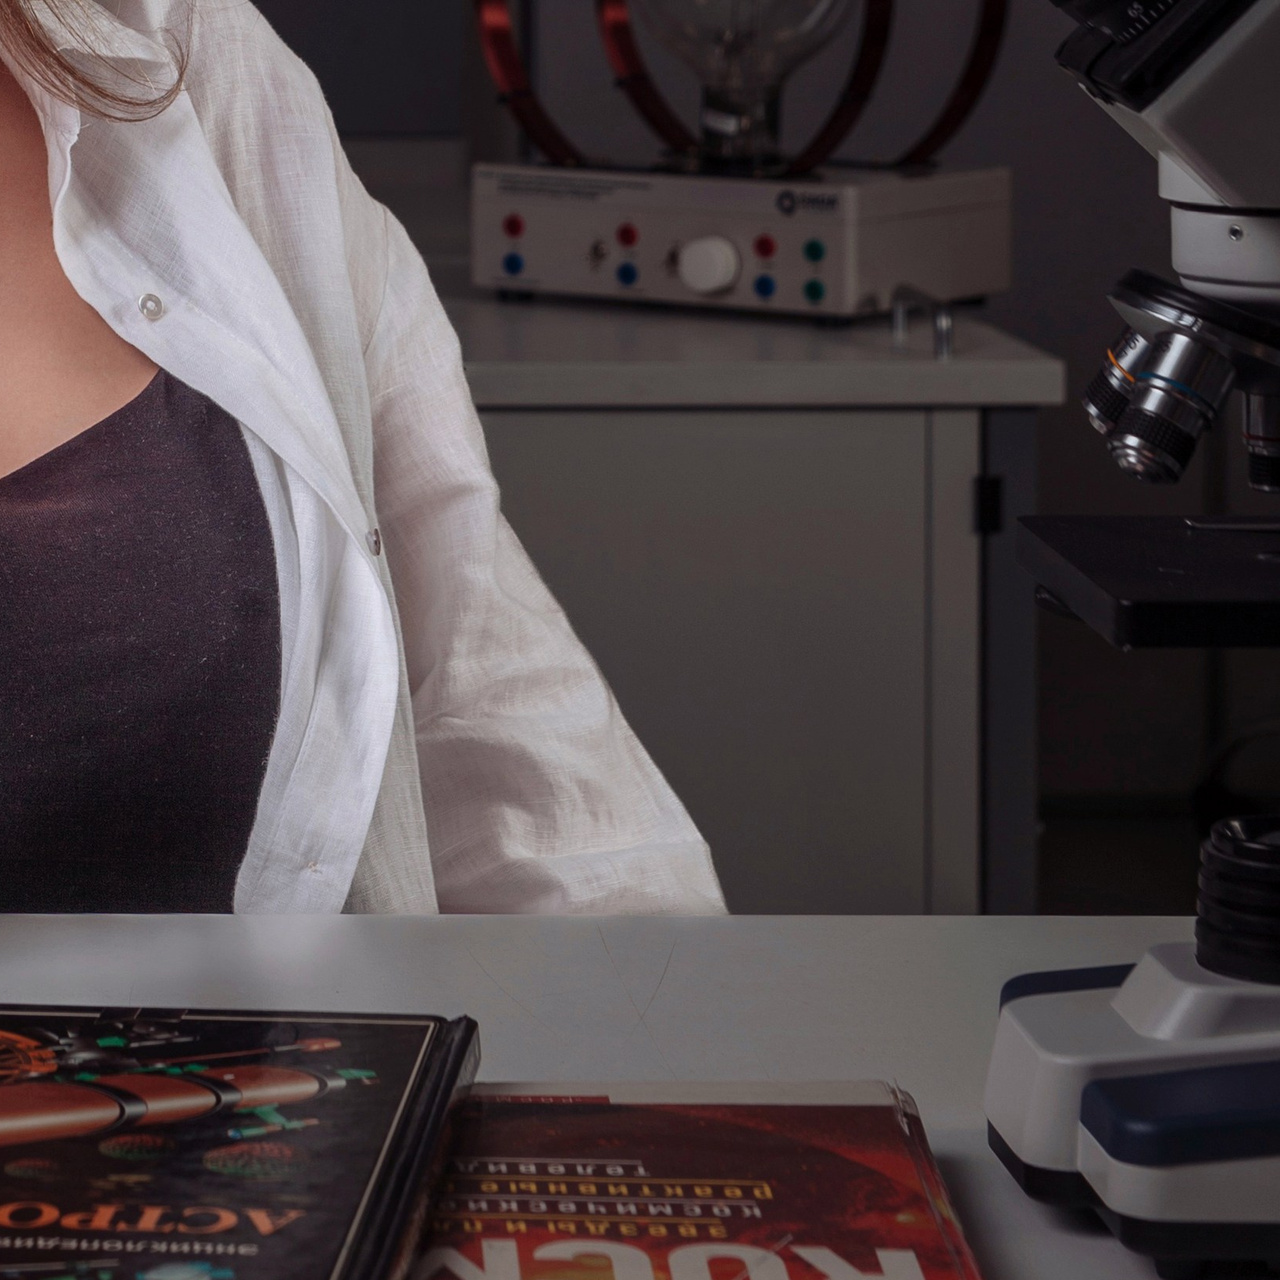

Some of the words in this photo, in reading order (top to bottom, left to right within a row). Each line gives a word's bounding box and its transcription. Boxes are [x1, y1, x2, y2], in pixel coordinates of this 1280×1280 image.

[1127, 1, 1145, 18] 65
[480, 1182, 773, 1201] реактивные
[505, 1220, 528, 1234] и
[547, 1220, 729, 1239] звезды
